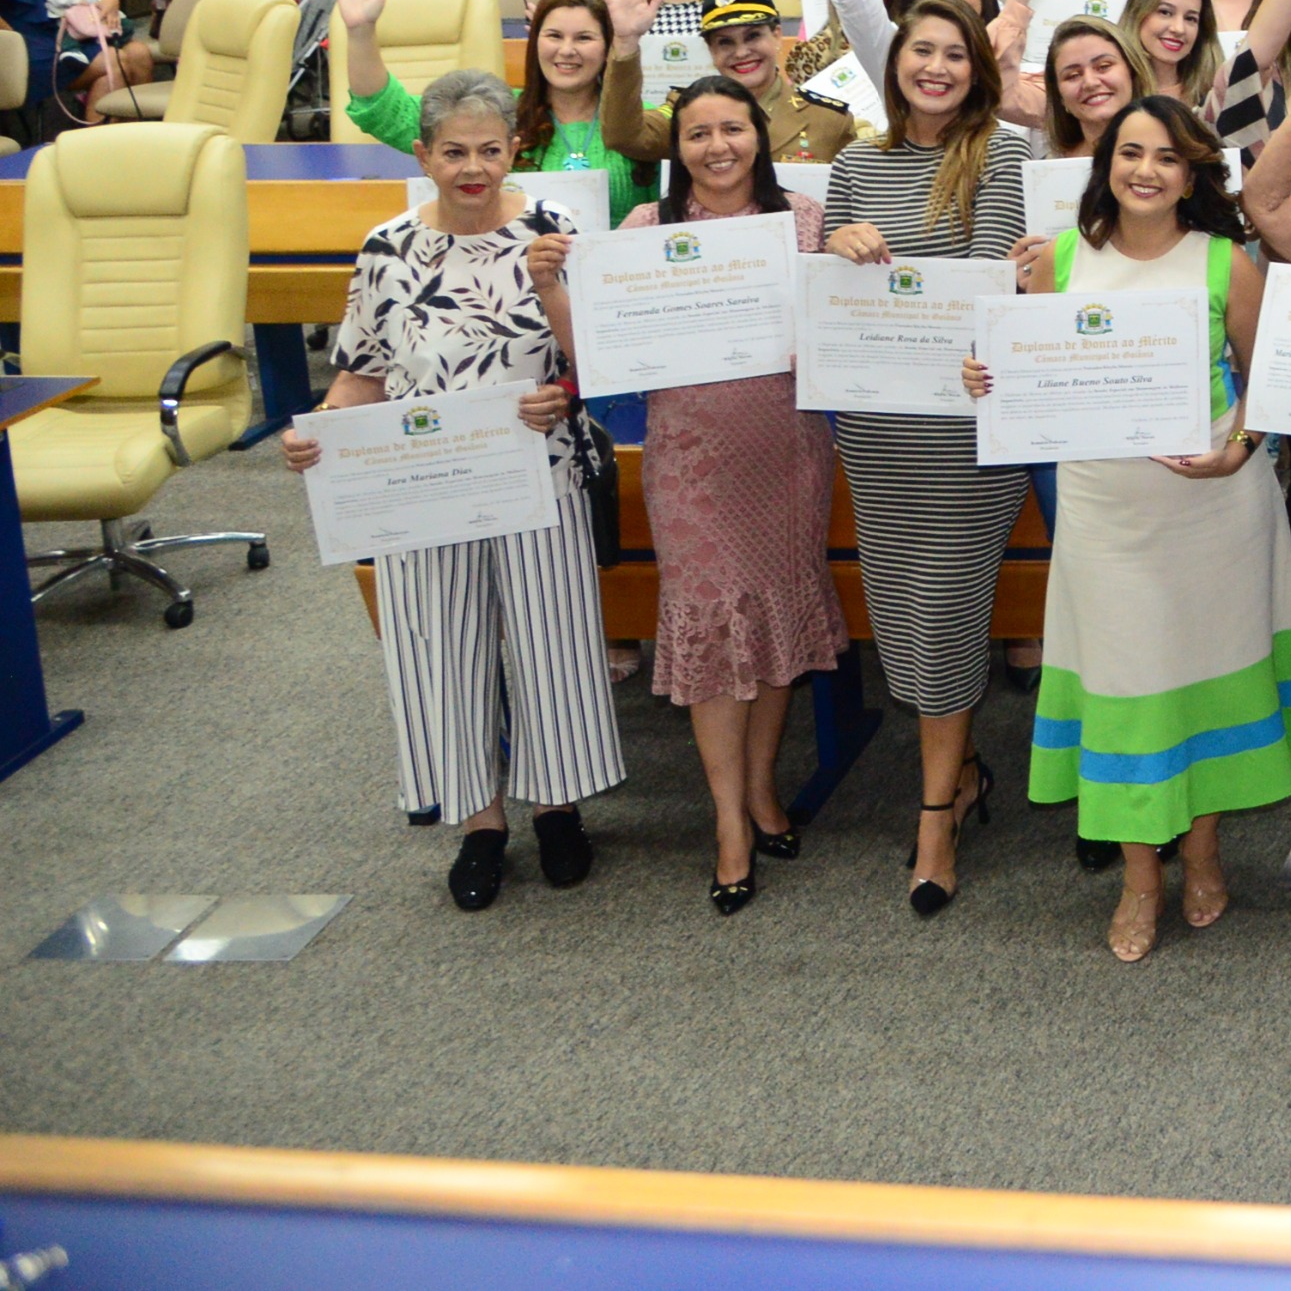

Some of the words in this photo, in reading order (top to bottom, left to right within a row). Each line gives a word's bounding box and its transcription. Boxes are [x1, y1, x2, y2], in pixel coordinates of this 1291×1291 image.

[1055, 199, 1079, 212] Dipl
[602, 270, 650, 285] Diploma
[655, 268, 667, 278] de
[671, 264, 708, 276] Honra
[712, 263, 723, 272] ao
[728, 257, 767, 270] Mérito
[829, 296, 875, 308] Diploma
[878, 298, 889, 307] de
[893, 297, 928, 310] Honra
[932, 301, 943, 310] ao
[947, 300, 975, 311] Méri
[617, 306, 660, 319] Fernanda
[1011, 341, 1061, 354] Diploma
[1065, 340, 1076, 350] de
[1081, 338, 1119, 350] Honra
[1122, 338, 1134, 347] ao
[1138, 334, 1177, 347] Mérito
[1037, 379, 1069, 388] Liliane
[1072, 378, 1100, 387] Bueno
[1103, 376, 1128, 386] Souto
[1130, 375, 1152, 384] Silva
[410, 471, 449, 483] Mariana
[452, 467, 472, 477] Dias
